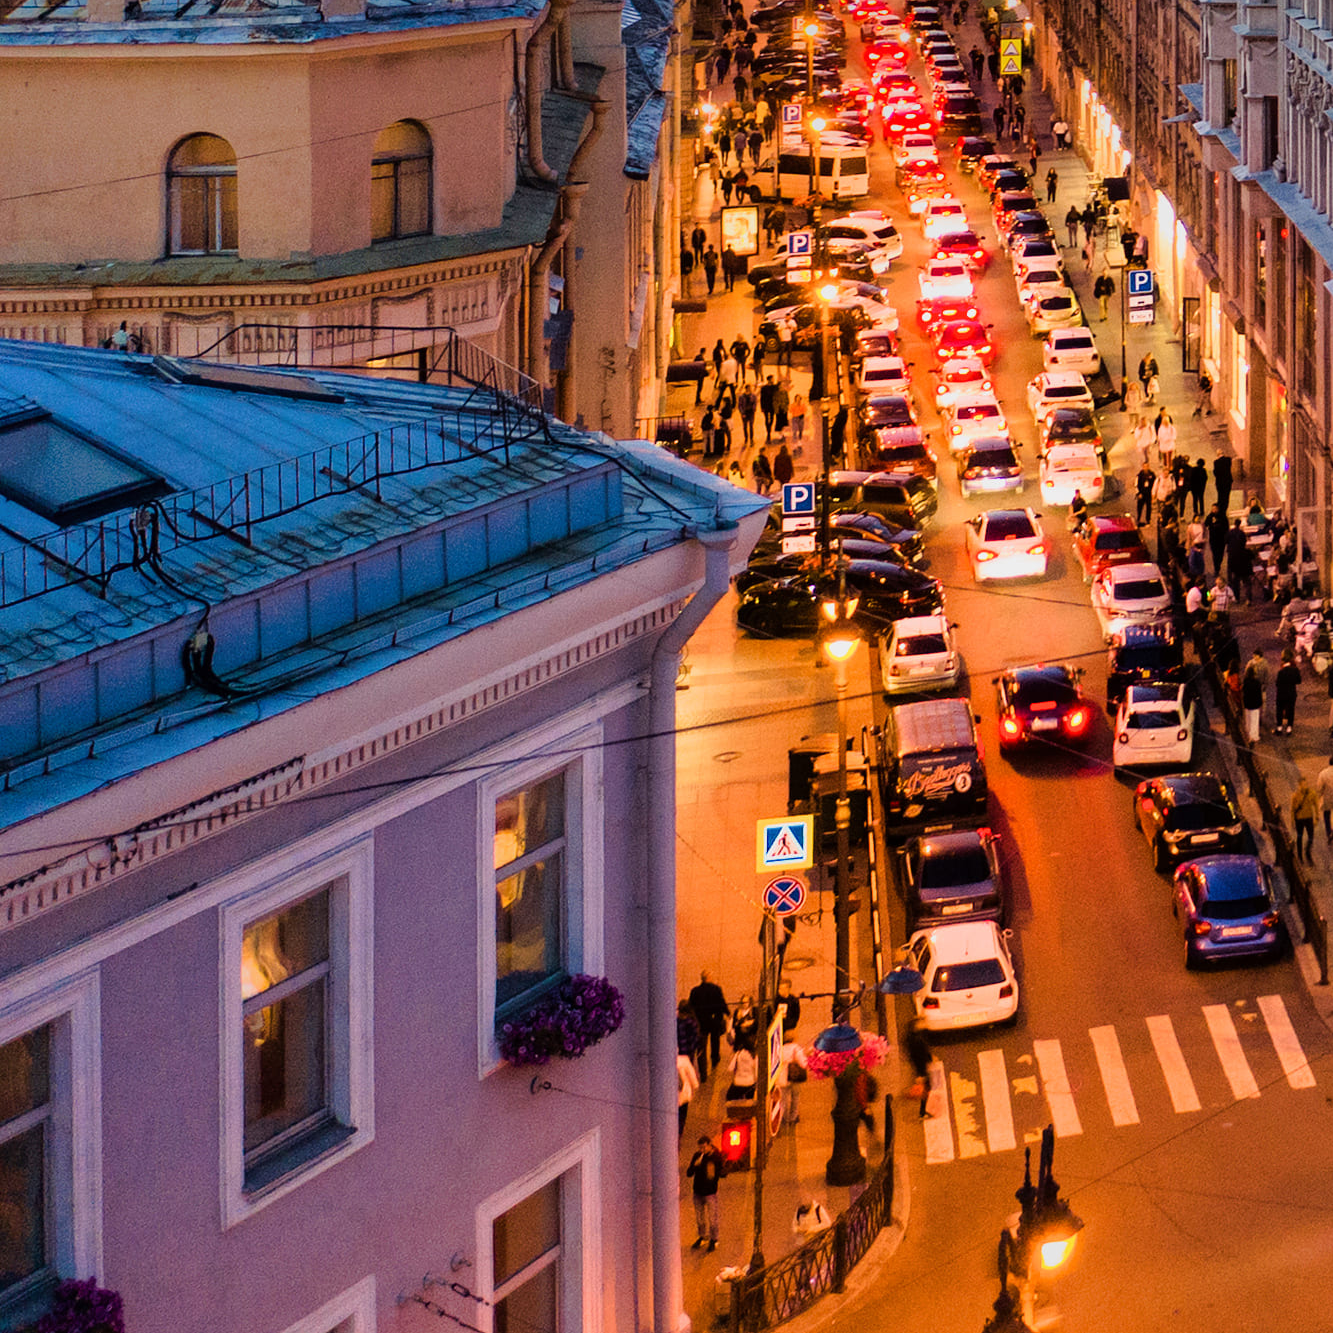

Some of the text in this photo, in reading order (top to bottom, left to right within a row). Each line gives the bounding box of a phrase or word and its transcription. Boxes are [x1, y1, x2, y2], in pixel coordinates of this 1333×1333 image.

[792, 235, 807, 253] P
[1135, 272, 1149, 291] P
[790, 486, 809, 511] P
